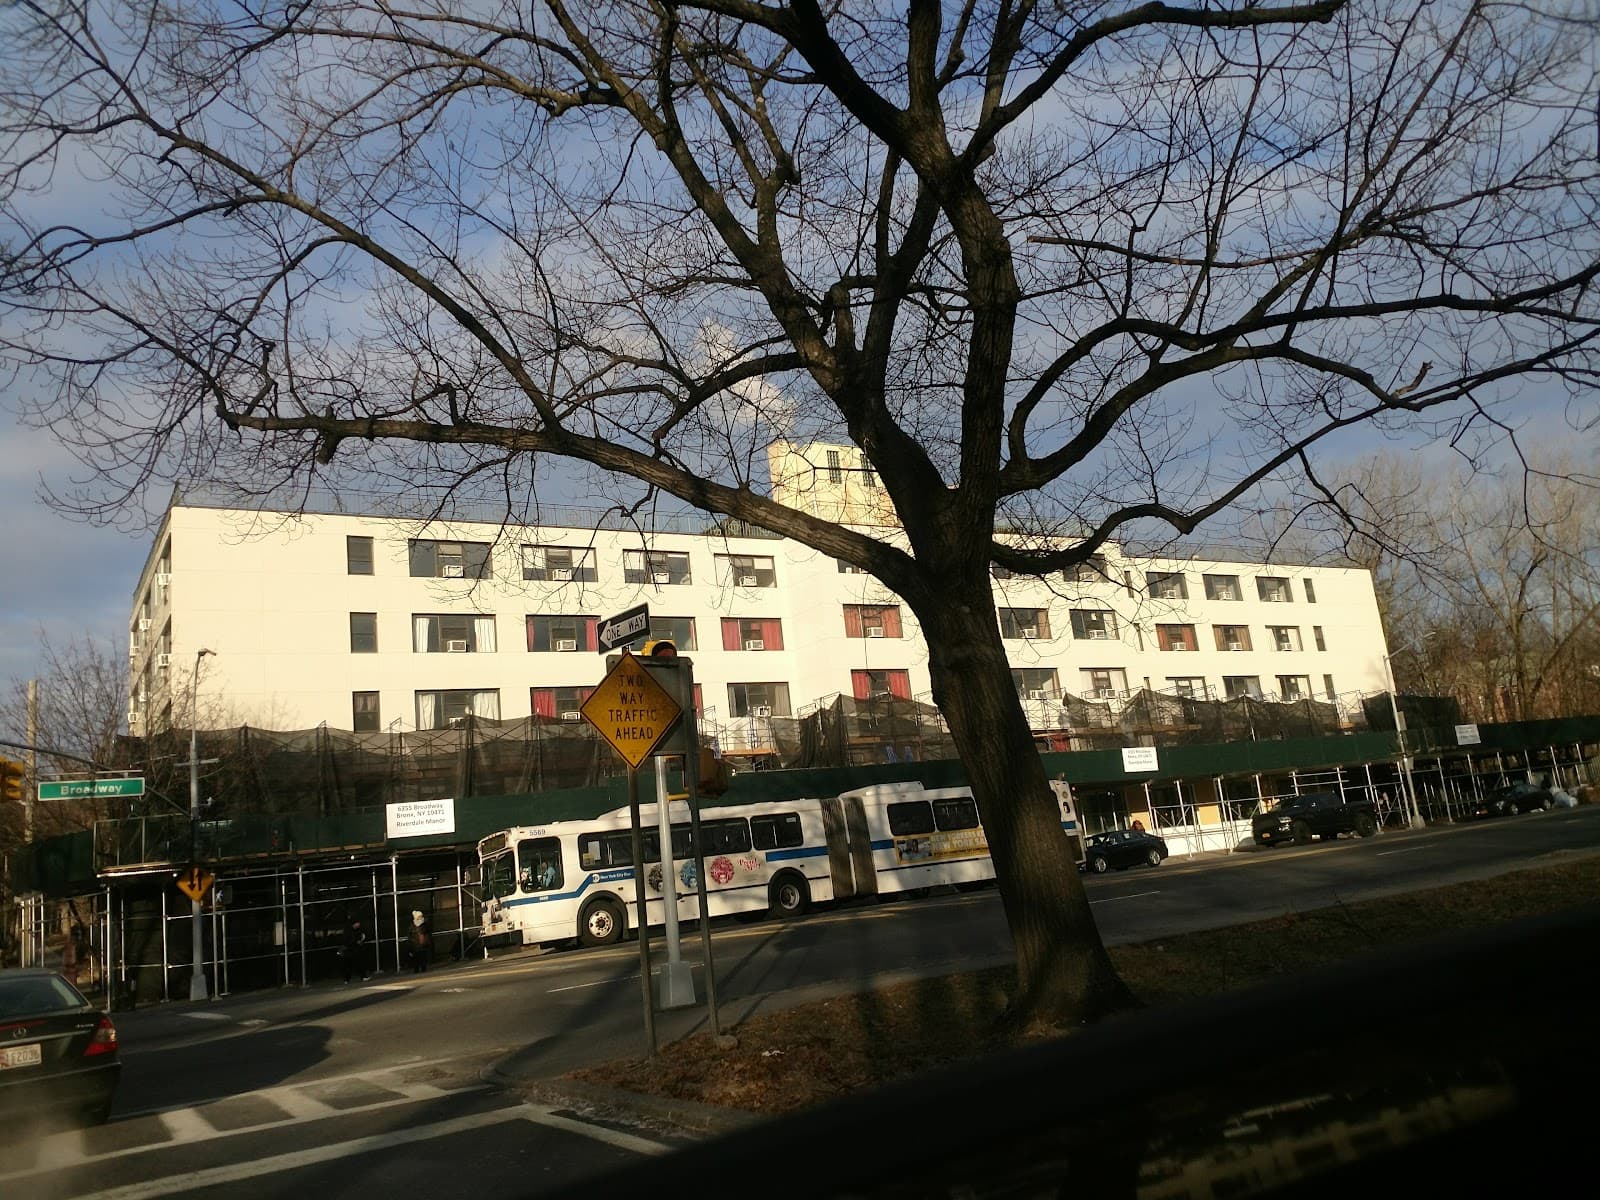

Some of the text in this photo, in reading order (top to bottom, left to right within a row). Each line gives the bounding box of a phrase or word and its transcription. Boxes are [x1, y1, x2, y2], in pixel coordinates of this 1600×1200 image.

[606, 615, 645, 641] ONE WAY
[618, 675, 643, 687] TWO
[620, 692, 645, 704] WAY
[608, 709, 657, 722] TRAFFIC
[615, 727, 653, 740] AHEAD
[60, 784, 122, 796] Broadway
[413, 803, 443, 811] Broadway
